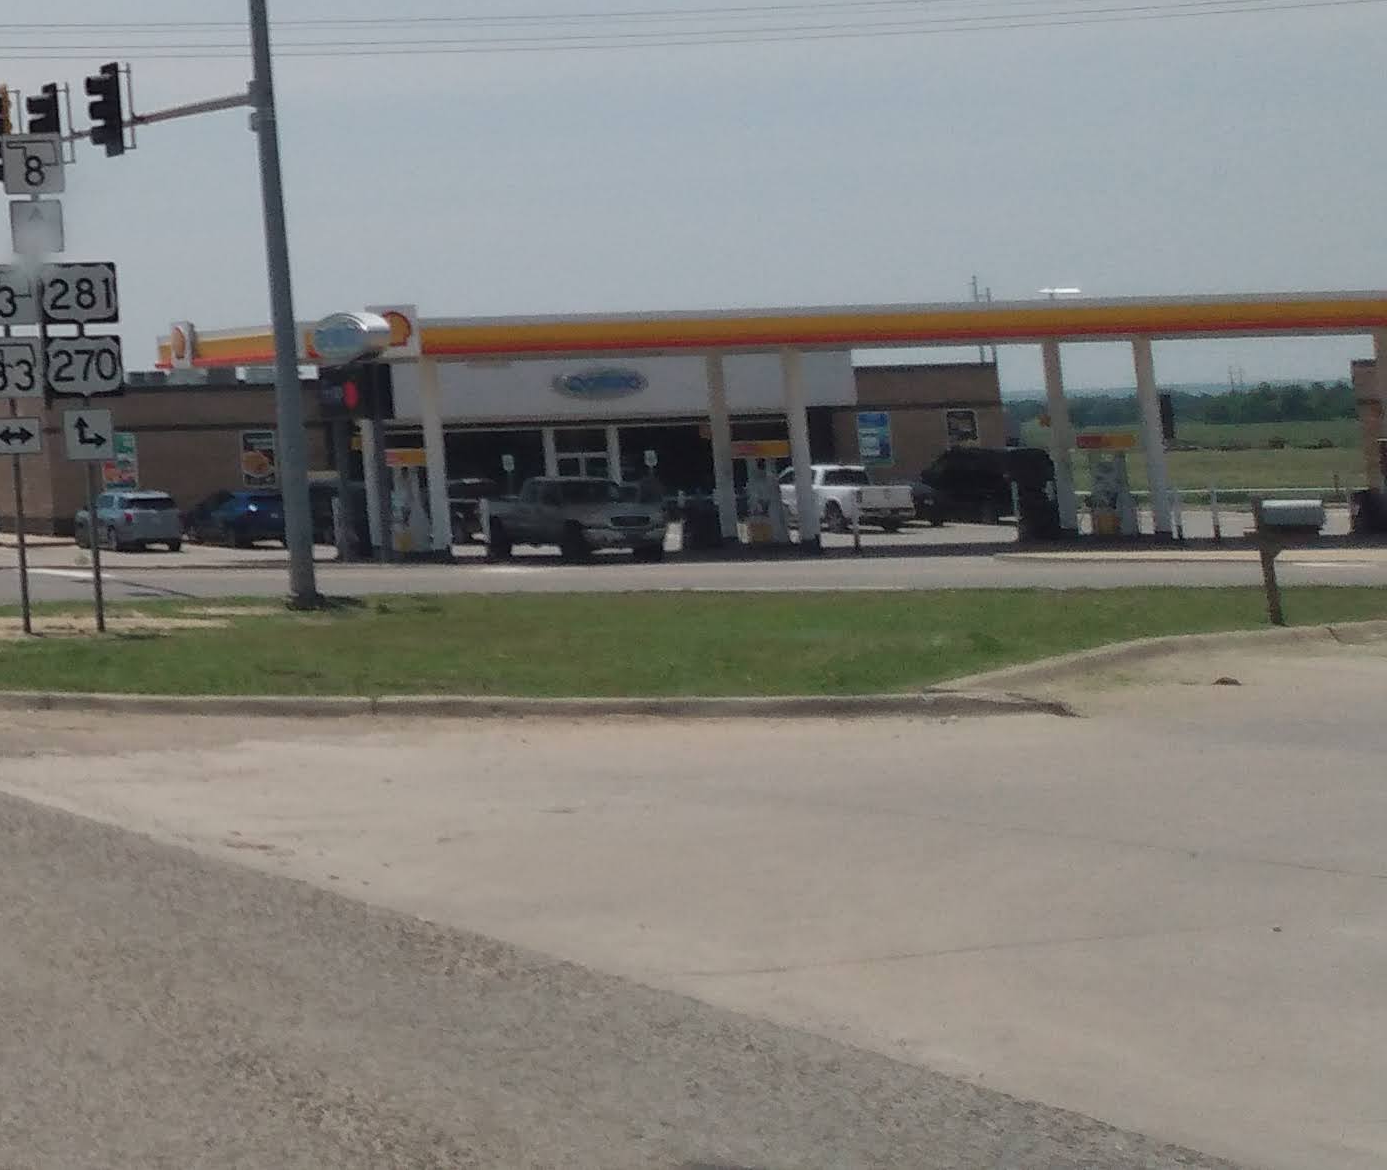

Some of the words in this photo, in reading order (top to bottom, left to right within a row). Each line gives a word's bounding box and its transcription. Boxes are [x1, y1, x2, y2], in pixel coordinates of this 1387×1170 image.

[25, 155, 45, 186] 8
[49, 277, 113, 310] 281
[52, 347, 118, 381] 270
